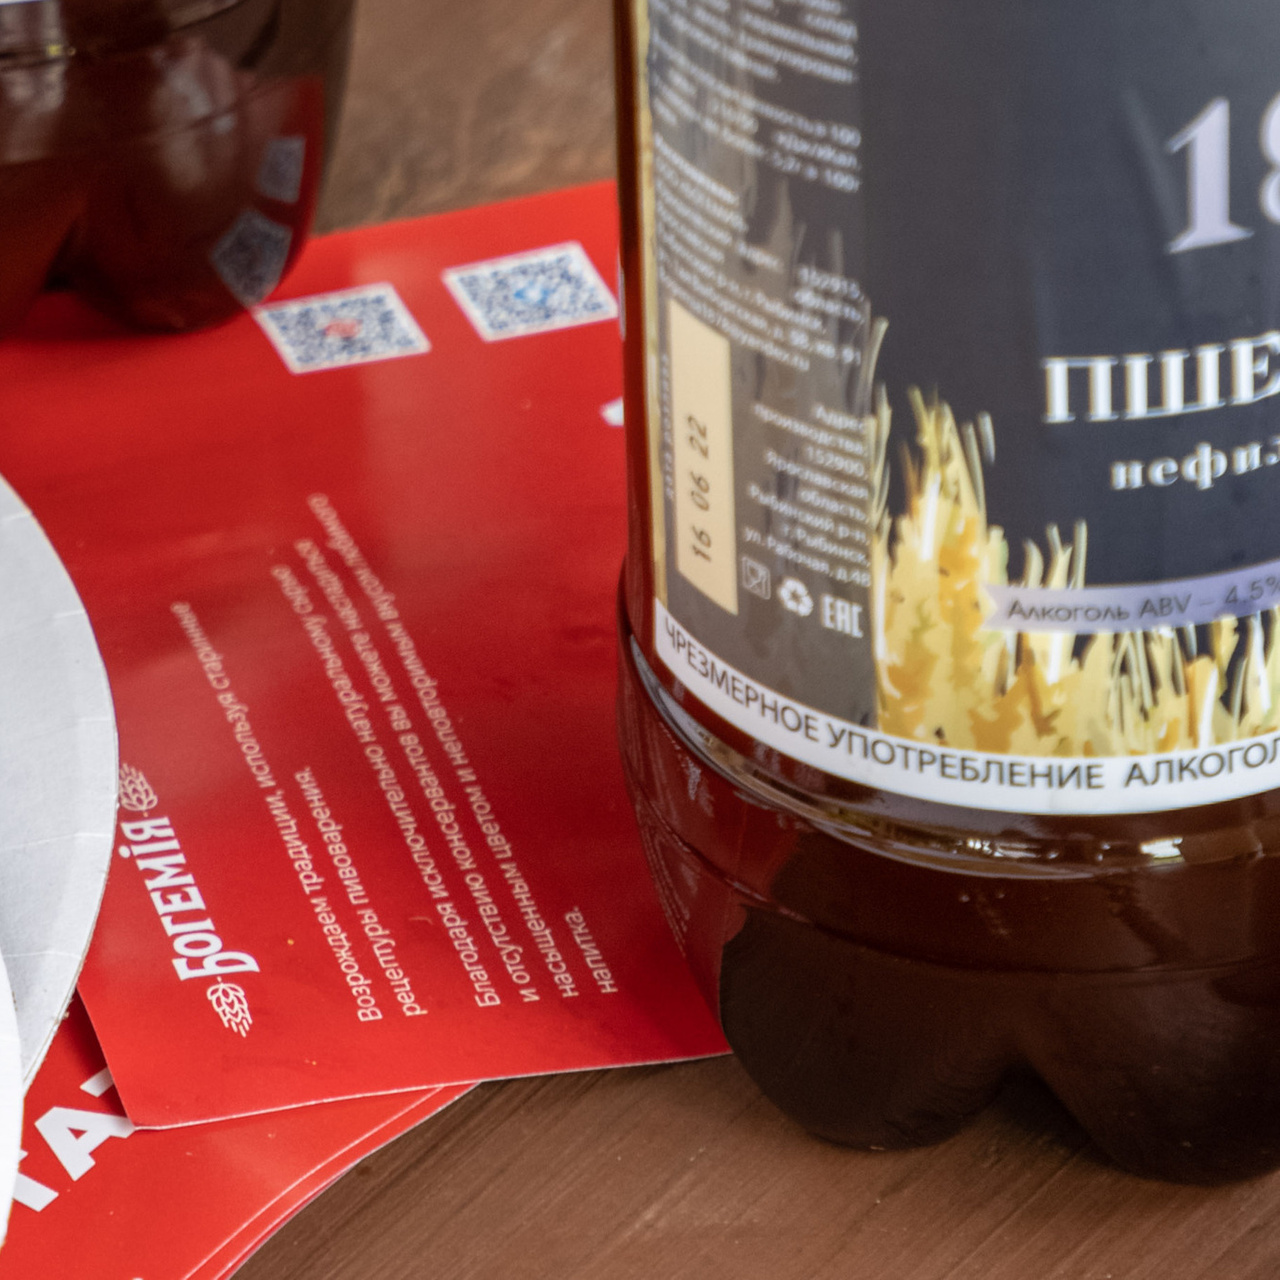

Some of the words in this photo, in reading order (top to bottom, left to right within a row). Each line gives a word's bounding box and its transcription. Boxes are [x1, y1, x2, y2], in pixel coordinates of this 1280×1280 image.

[686, 413, 710, 462] 22
[689, 471, 712, 514] 06
[691, 524, 713, 565] 16
[271, 566, 313, 615] сырью
[355, 568, 398, 620] вкусом
[1139, 593, 1192, 620] ABV
[173, 604, 230, 690] старинные
[302, 616, 376, 742] натуральному
[351, 632, 397, 702] можете
[386, 621, 468, 765] неповторимым
[386, 705, 411, 731] вы
[664, 622, 819, 742] ЧРЕЗМЕРНОЕ
[826, 719, 1104, 790] УПОТРЕБЛЕНИЕ
[217, 691, 275, 787] используя
[457, 768, 476, 782] и
[266, 790, 324, 894] традиции,
[295, 768, 369, 904] пивоварения.
[365, 745, 449, 898] исключительно
[399, 733, 476, 870] консервантов
[465, 786, 512, 859] цветом
[311, 898, 382, 1021] Возрождаем
[358, 909, 428, 1016] рецептуры
[436, 903, 501, 1007] Благодаря
[465, 873, 530, 984] отсутствию
[500, 863, 578, 997] насыщенным
[565, 907, 617, 993] напитка.
[520, 989, 540, 1002] и
